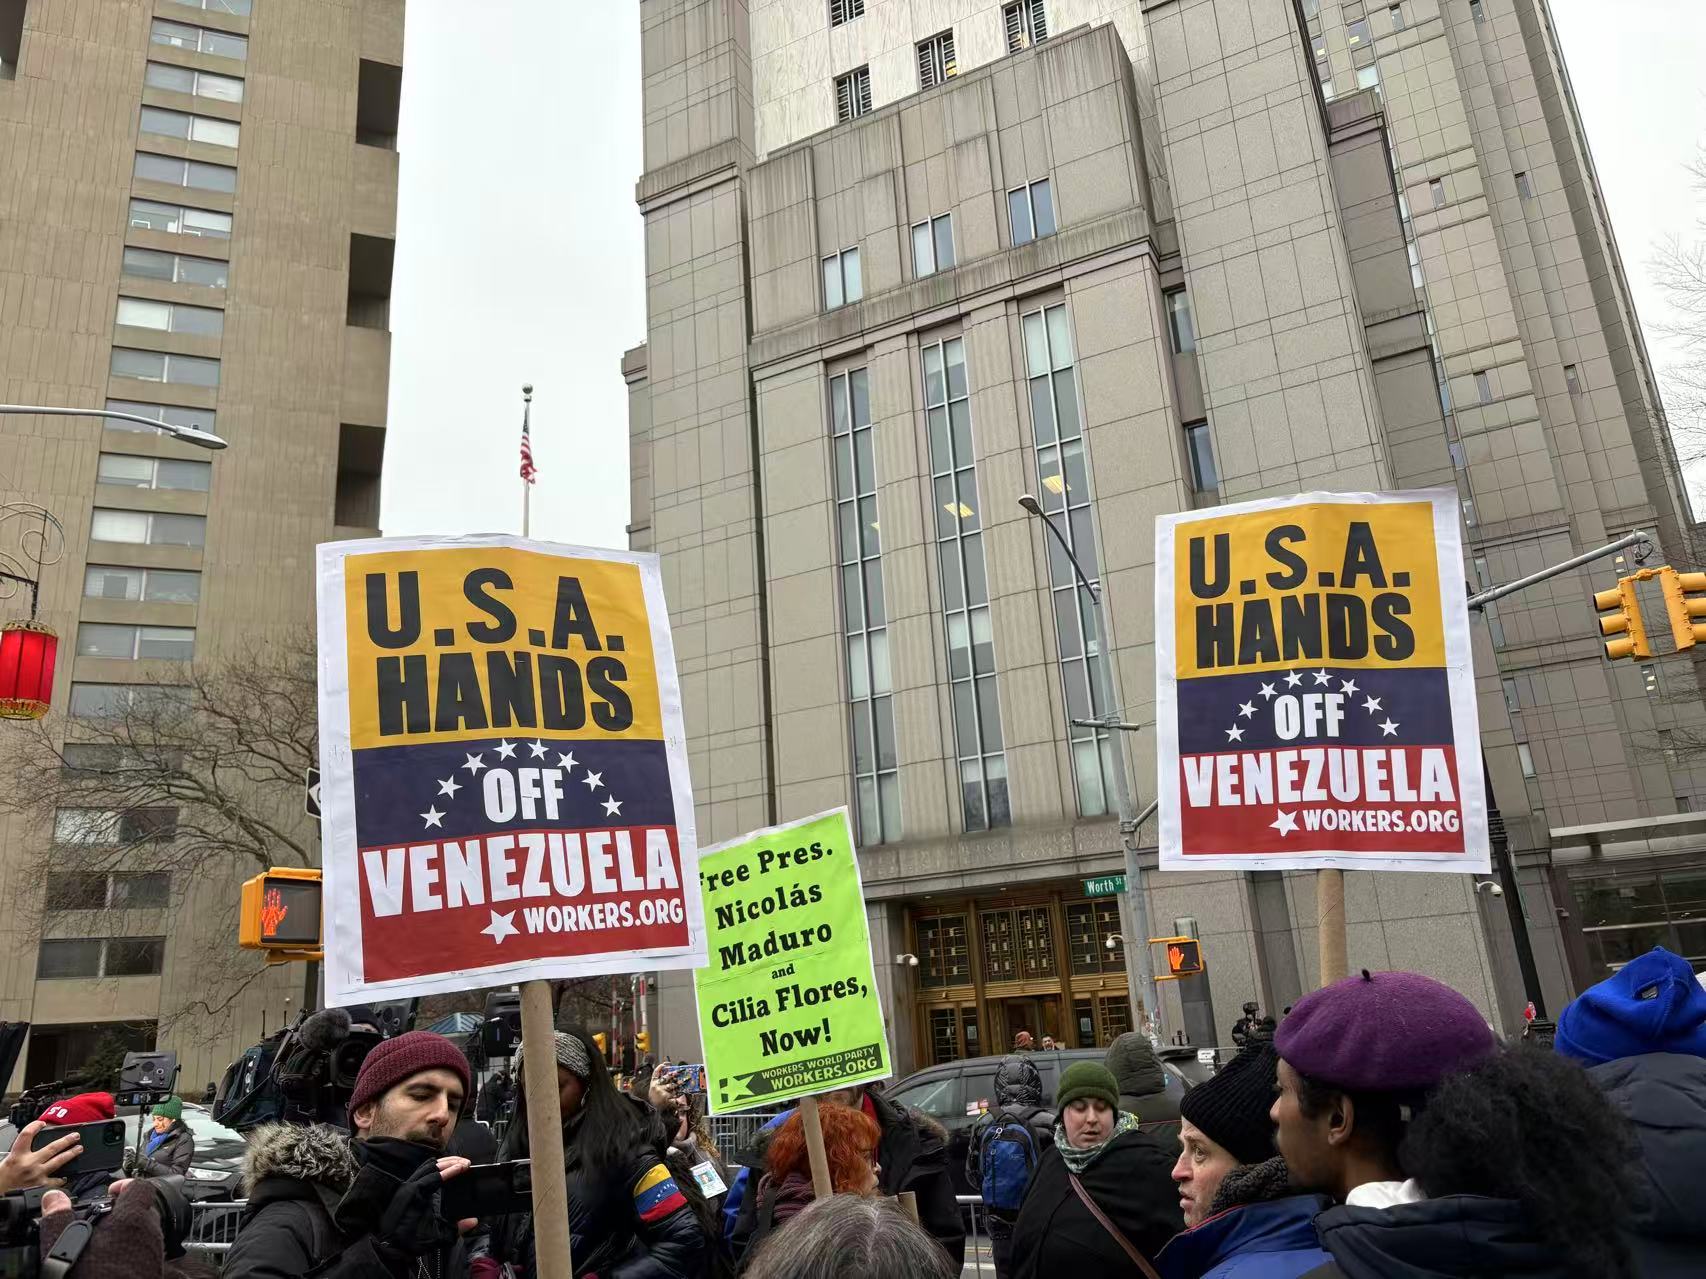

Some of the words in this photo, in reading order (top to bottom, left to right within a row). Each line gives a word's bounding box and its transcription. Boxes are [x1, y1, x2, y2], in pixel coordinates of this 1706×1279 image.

[1189, 521, 1411, 599] U.S.A.
[365, 567, 625, 652] U.S.A.
[1195, 592, 1415, 670] HANDS
[376, 651, 634, 737] HANDS
[1273, 693, 1345, 741] OFF
[483, 767, 565, 823] OFF
[1182, 748, 1457, 808] VENEZUELA
[1302, 808, 1460, 833] WORKERS.ORG
[362, 828, 680, 918] VENEZUELA
[758, 841, 833, 874] Pres.
[715, 883, 822, 930] Nicolás
[1087, 880, 1114, 894] Worth
[523, 898, 684, 934] WORKERS.ORG
[718, 922, 832, 971] Maduro
[771, 963, 795, 980] and
[711, 996, 771, 1028] Cilia
[775, 976, 868, 1012] Flores,
[759, 1017, 832, 1057] Now!
[761, 1062, 804, 1080] WORKERS
[807, 1053, 843, 1069] WORLD
[845, 1046, 875, 1061] PARTY
[770, 1056, 878, 1091] WORKERS.ORG
